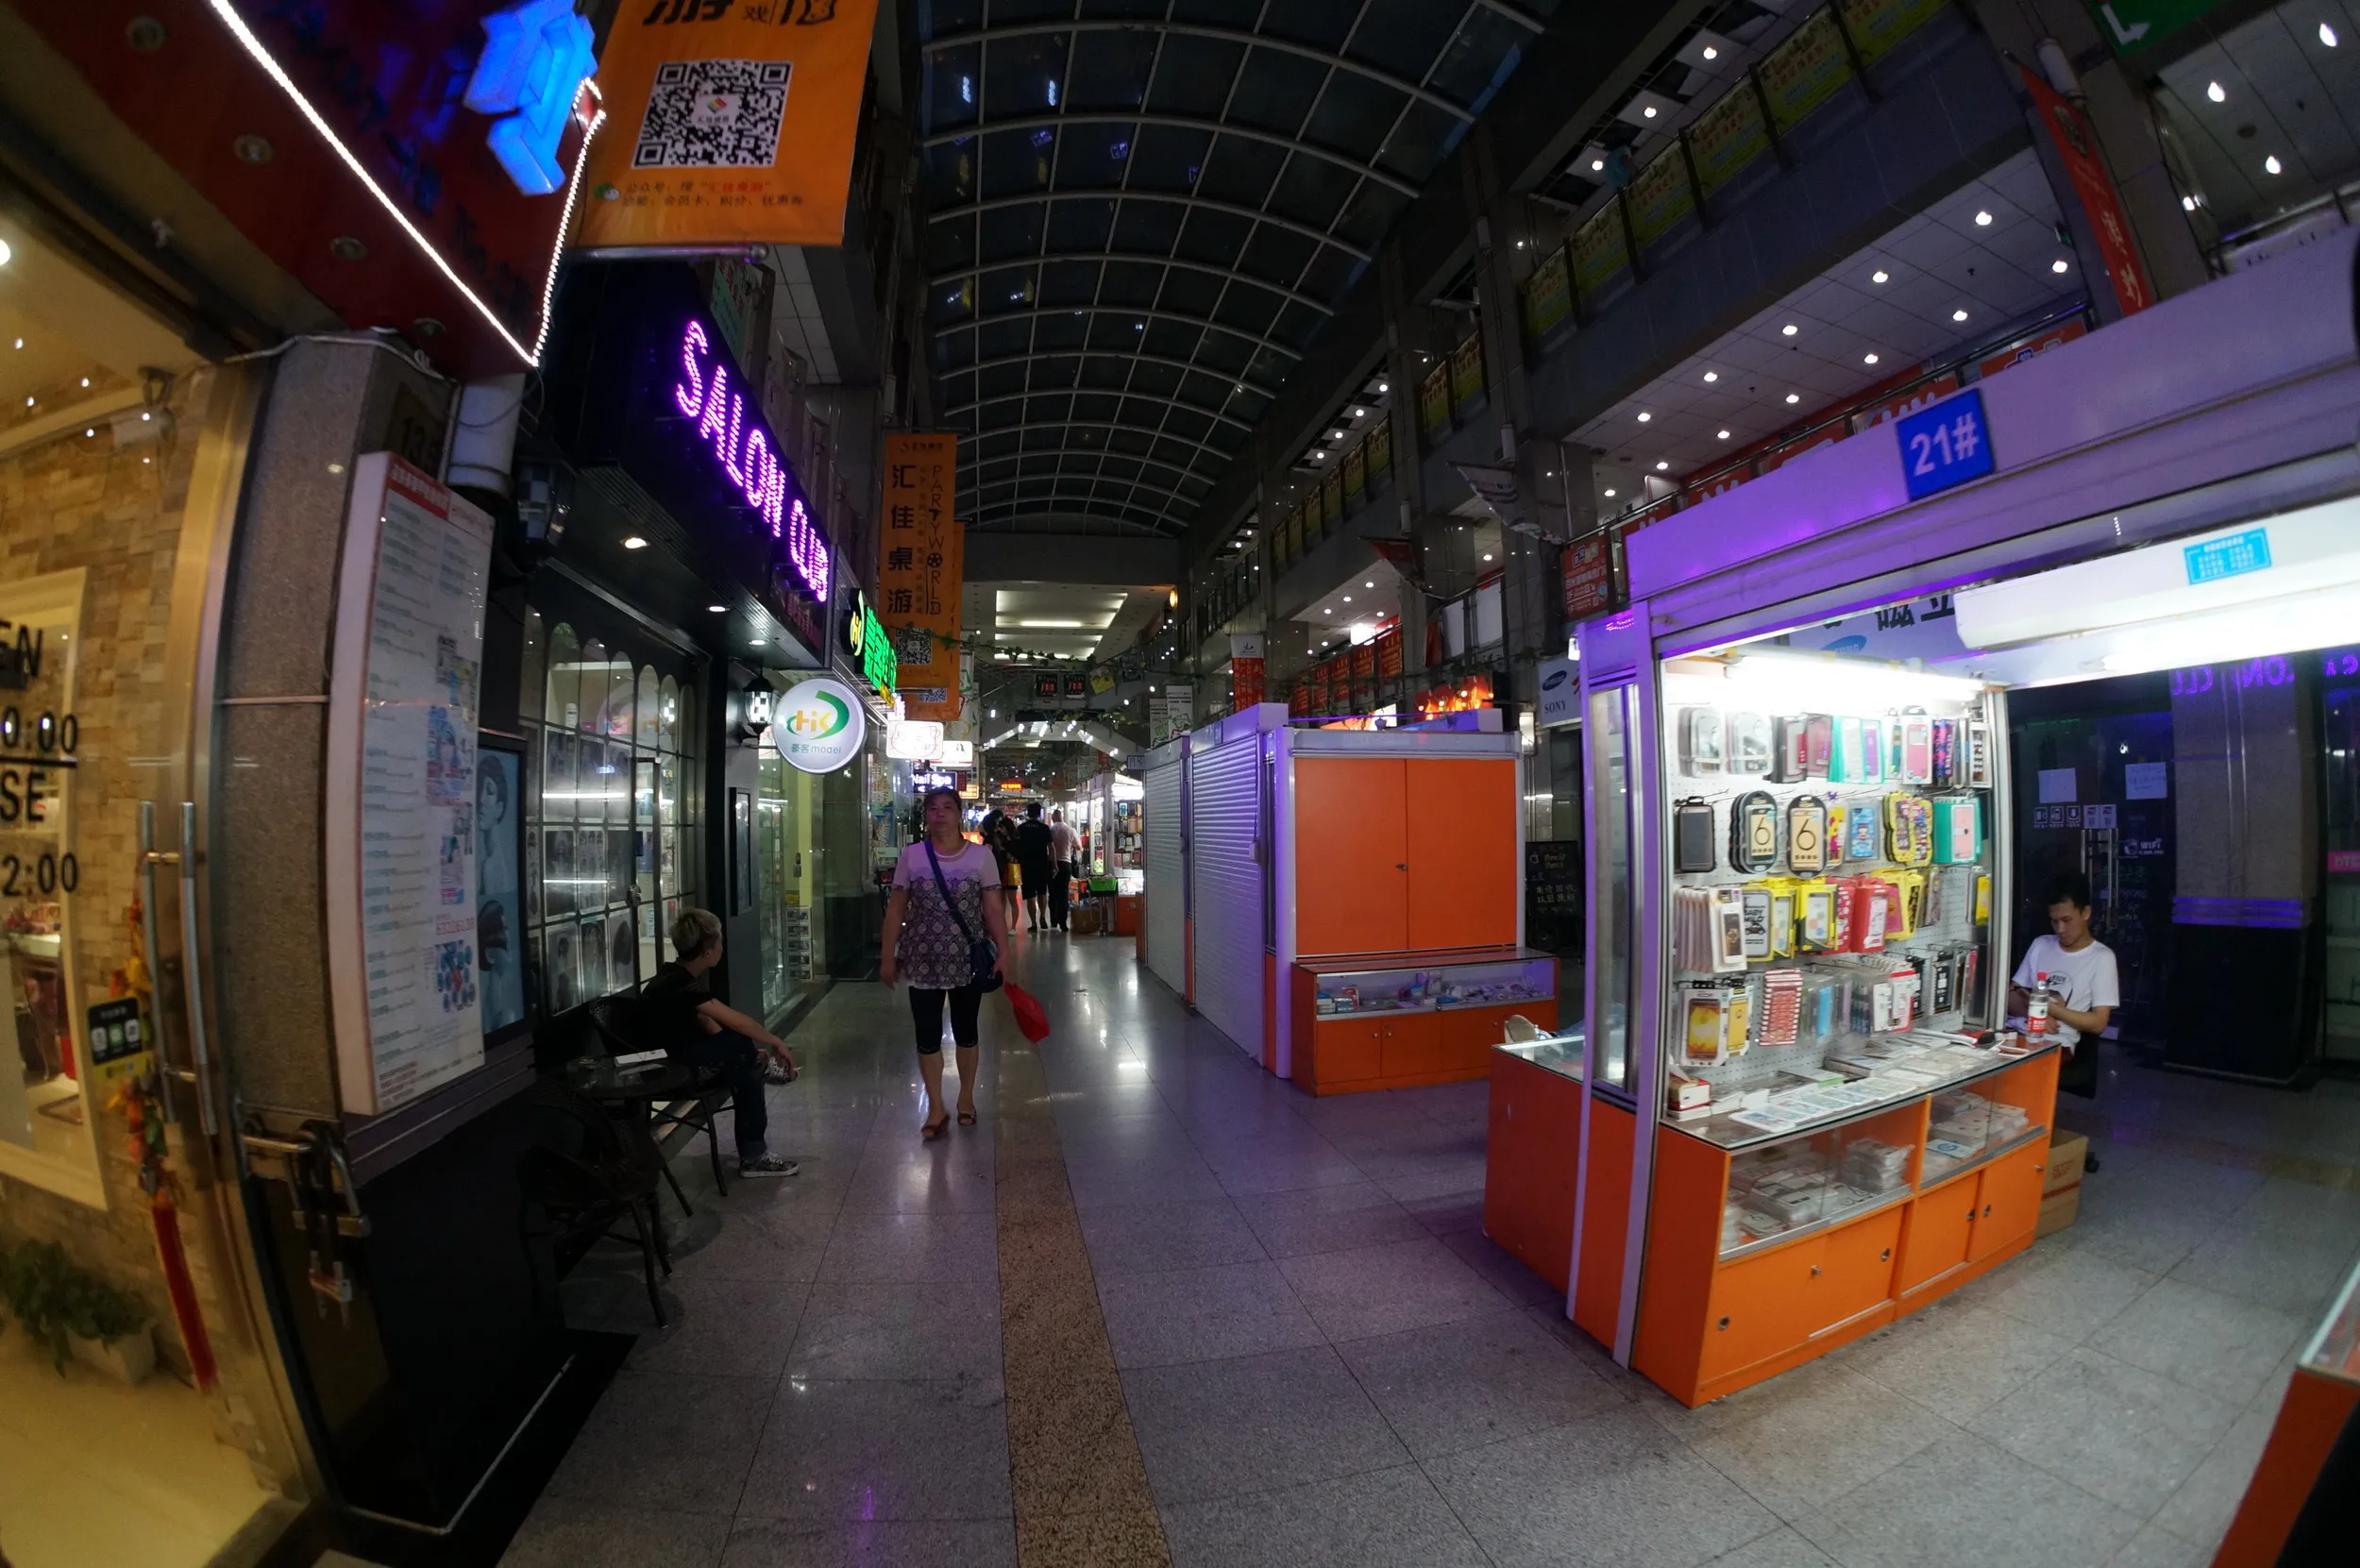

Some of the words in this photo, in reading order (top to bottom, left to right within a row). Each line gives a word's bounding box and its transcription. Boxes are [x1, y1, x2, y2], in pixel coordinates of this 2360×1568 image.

[677, 320, 786, 538] SALON
[1908, 411, 1981, 478] 21#
[886, 464, 917, 615] 汇佳桌游
[1544, 700, 1567, 715] SONY
[912, 773, 931, 785] Nail
[931, 773, 952, 786] Spa
[1754, 817, 1771, 846] 6
[1796, 818, 1816, 851] 6
